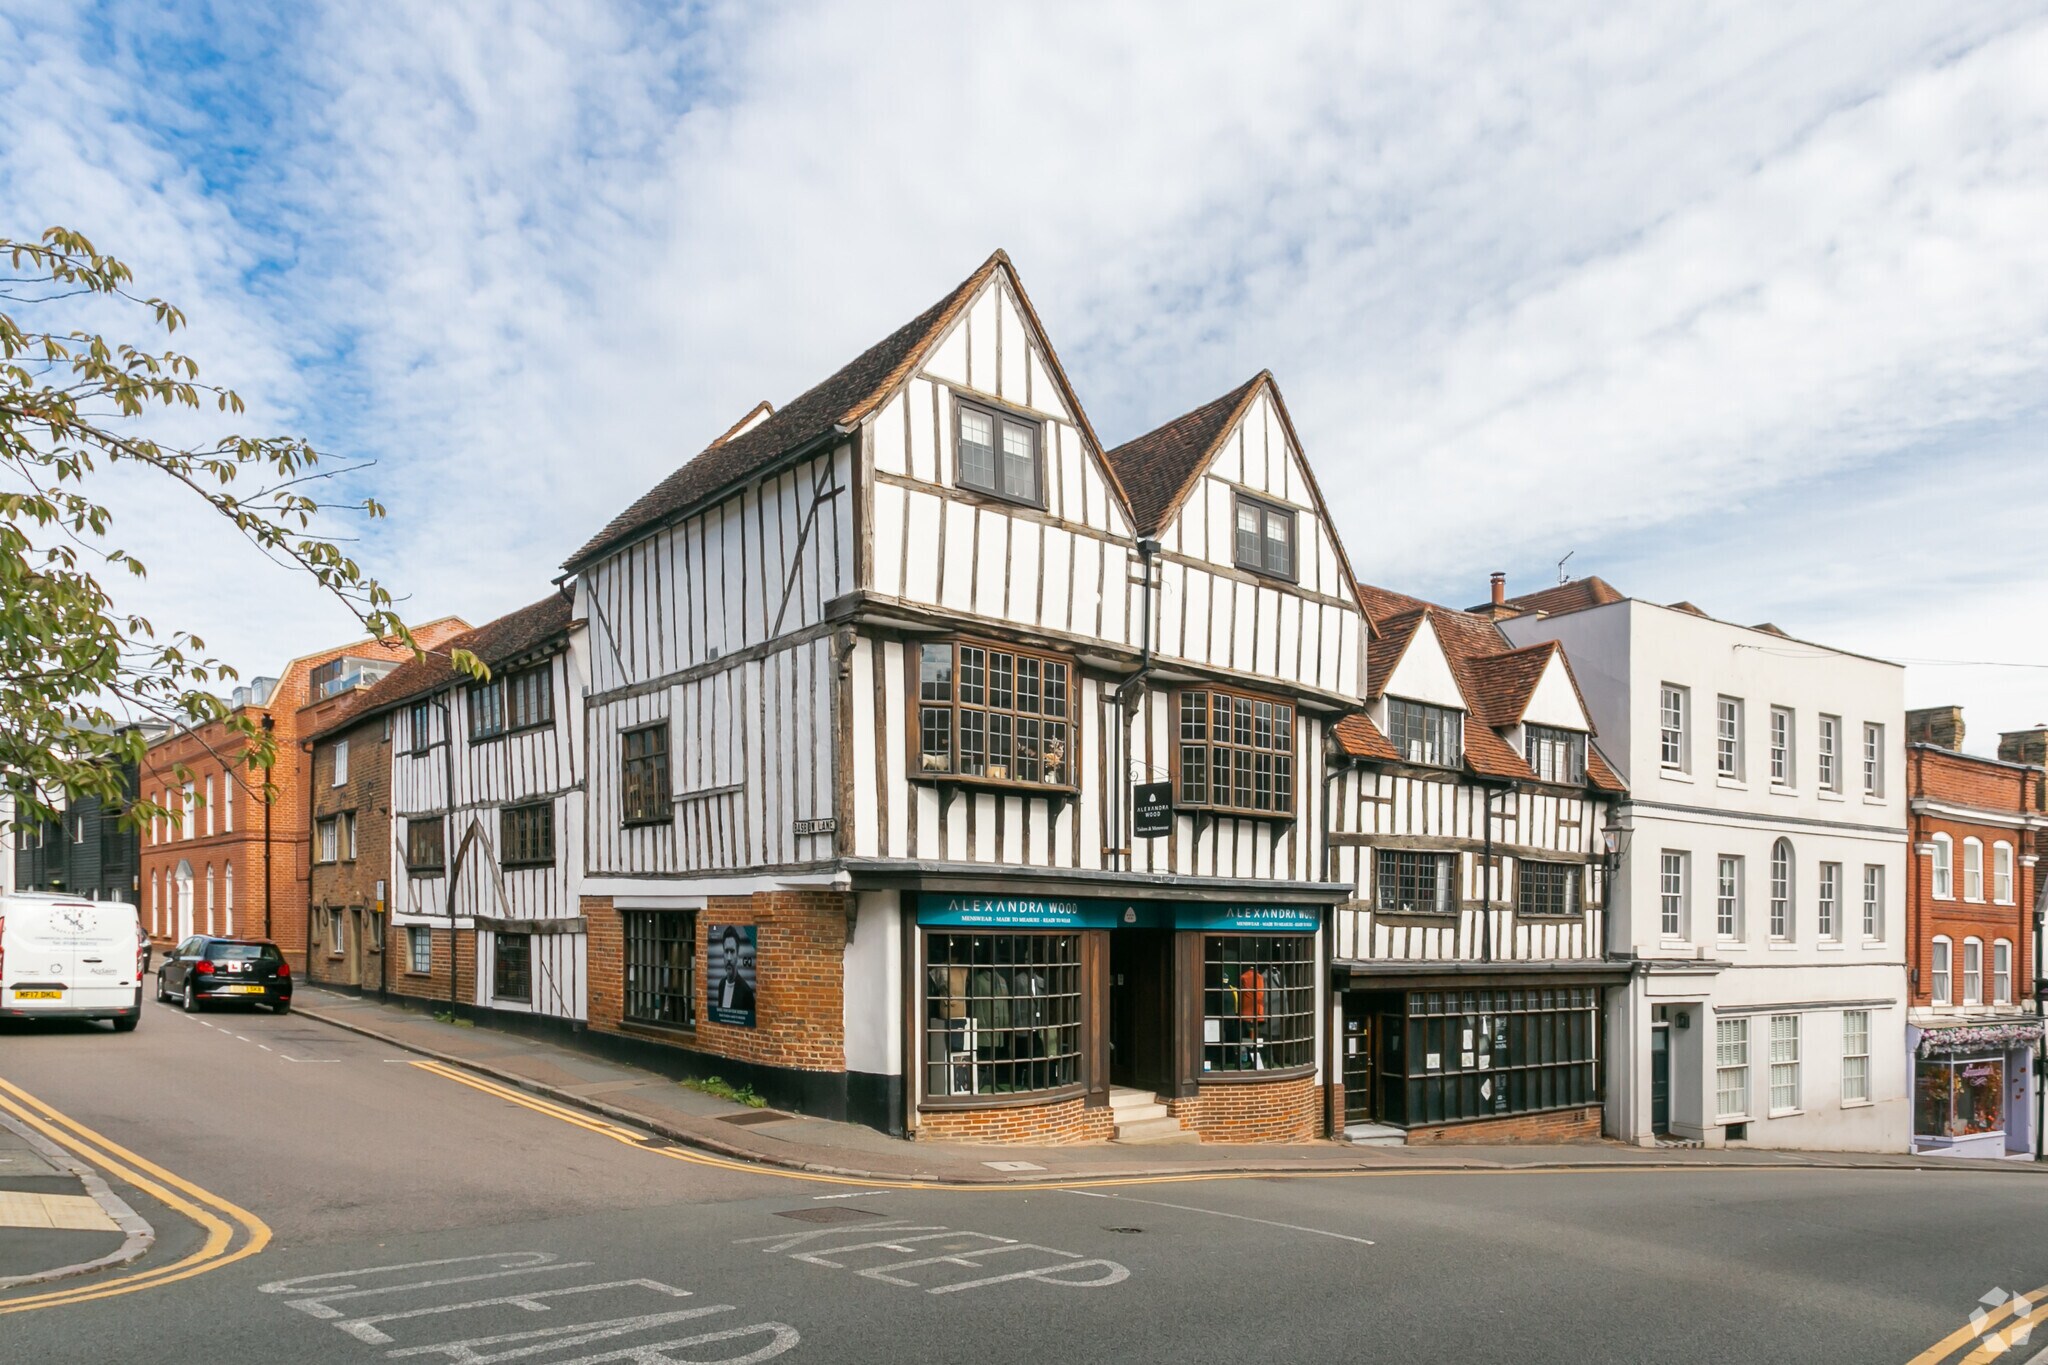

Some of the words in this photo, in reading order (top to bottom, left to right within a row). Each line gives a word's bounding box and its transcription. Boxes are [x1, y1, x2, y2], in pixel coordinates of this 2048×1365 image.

[1136, 804, 1169, 812] ALEXANDRA
[818, 820, 834, 830] LANE
[948, 899, 1044, 913] ALEXANDRA
[1048, 902, 1078, 914] WOOD
[1226, 907, 1296, 919] ALEXANDRA
[732, 1219, 1131, 1294] KEEP
